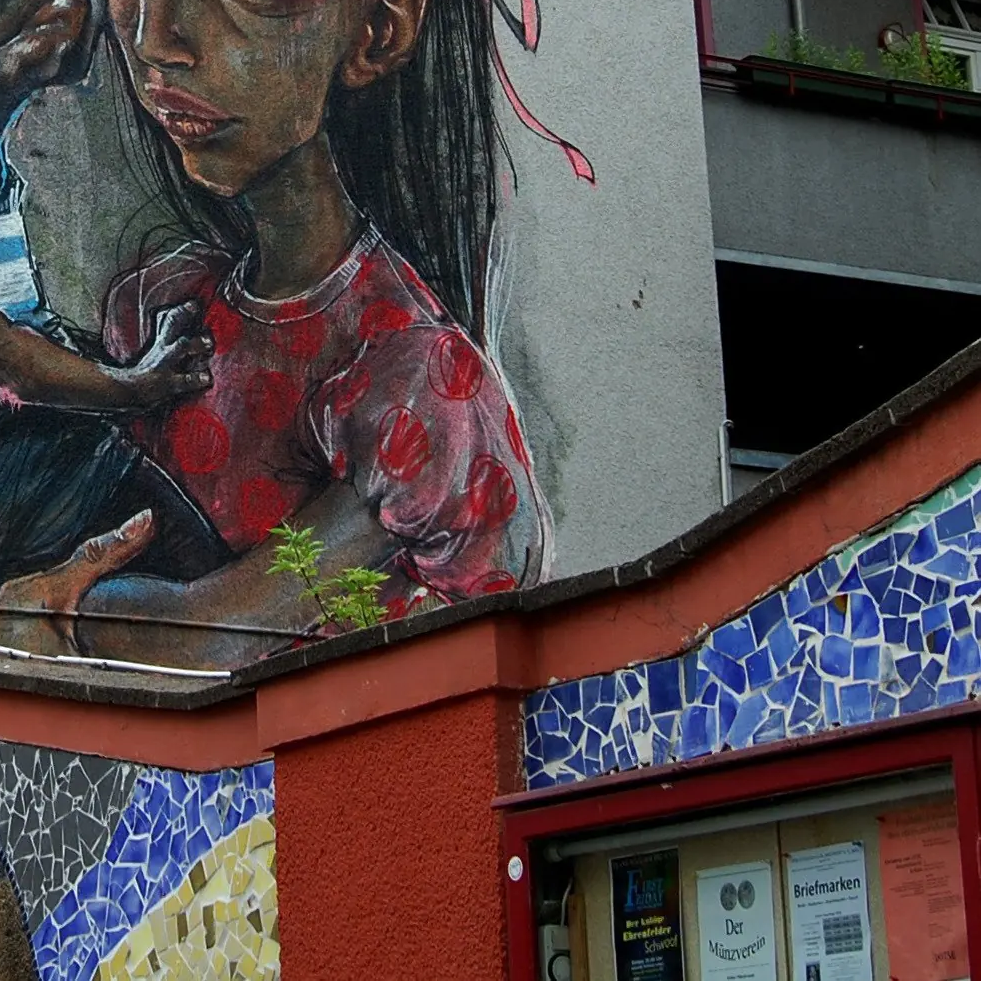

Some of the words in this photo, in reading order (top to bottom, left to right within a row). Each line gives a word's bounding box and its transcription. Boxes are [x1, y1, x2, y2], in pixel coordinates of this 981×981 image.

[793, 876, 861, 899] Briefmarken
[725, 918, 744, 936] Der
[708, 935, 766, 961] Münzverein
